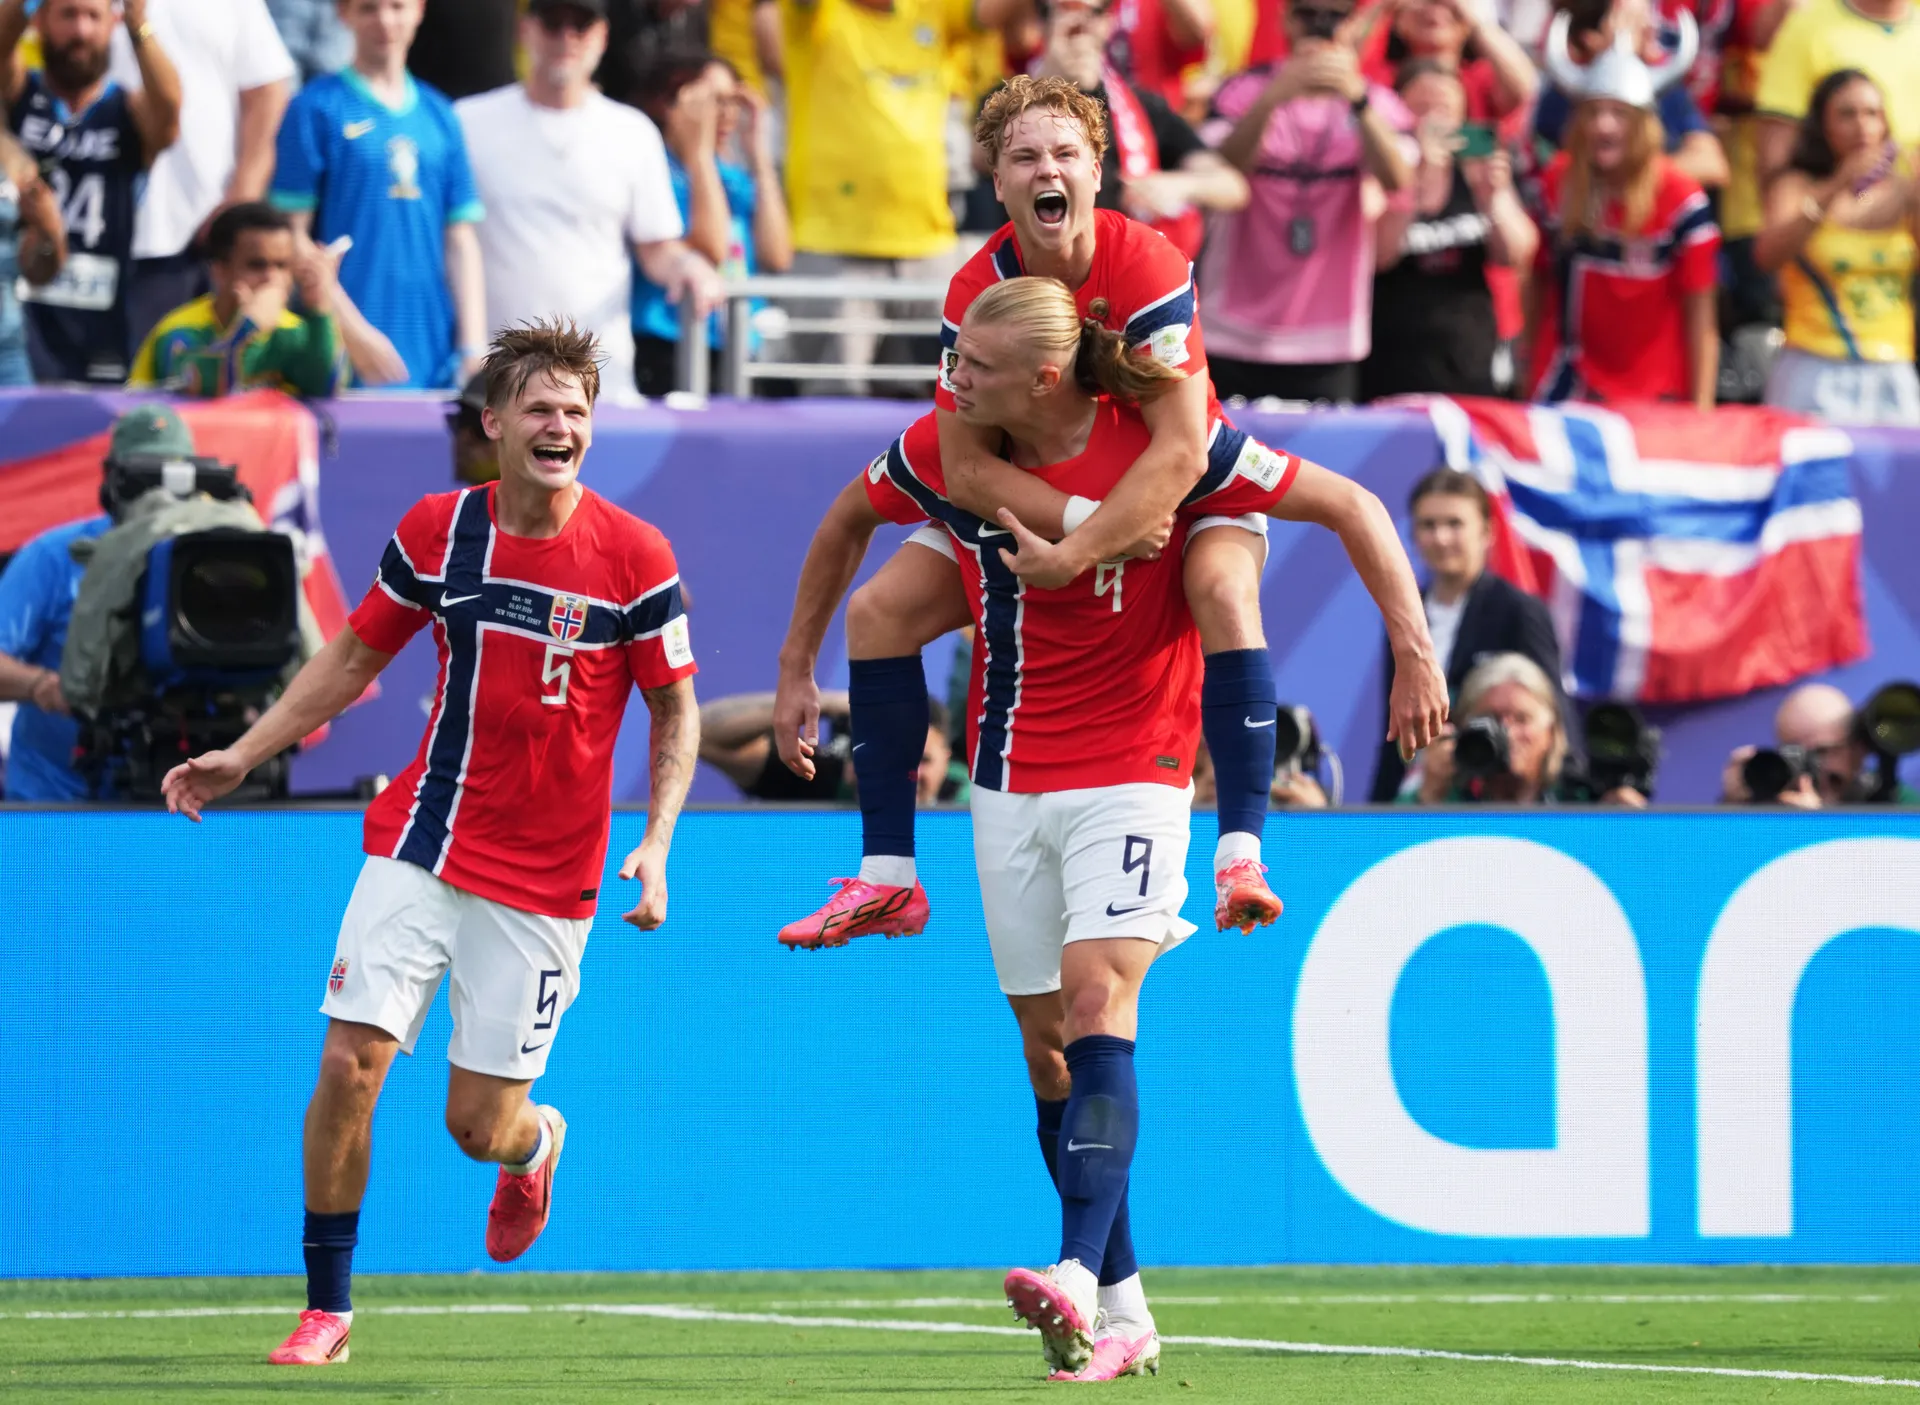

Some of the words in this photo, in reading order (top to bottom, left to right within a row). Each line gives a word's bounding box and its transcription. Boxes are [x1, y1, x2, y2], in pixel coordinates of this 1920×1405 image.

[1094, 561, 1124, 612] 9
[541, 644, 575, 705] 5
[1122, 834, 1153, 897] 9
[533, 968, 562, 1030] 5
